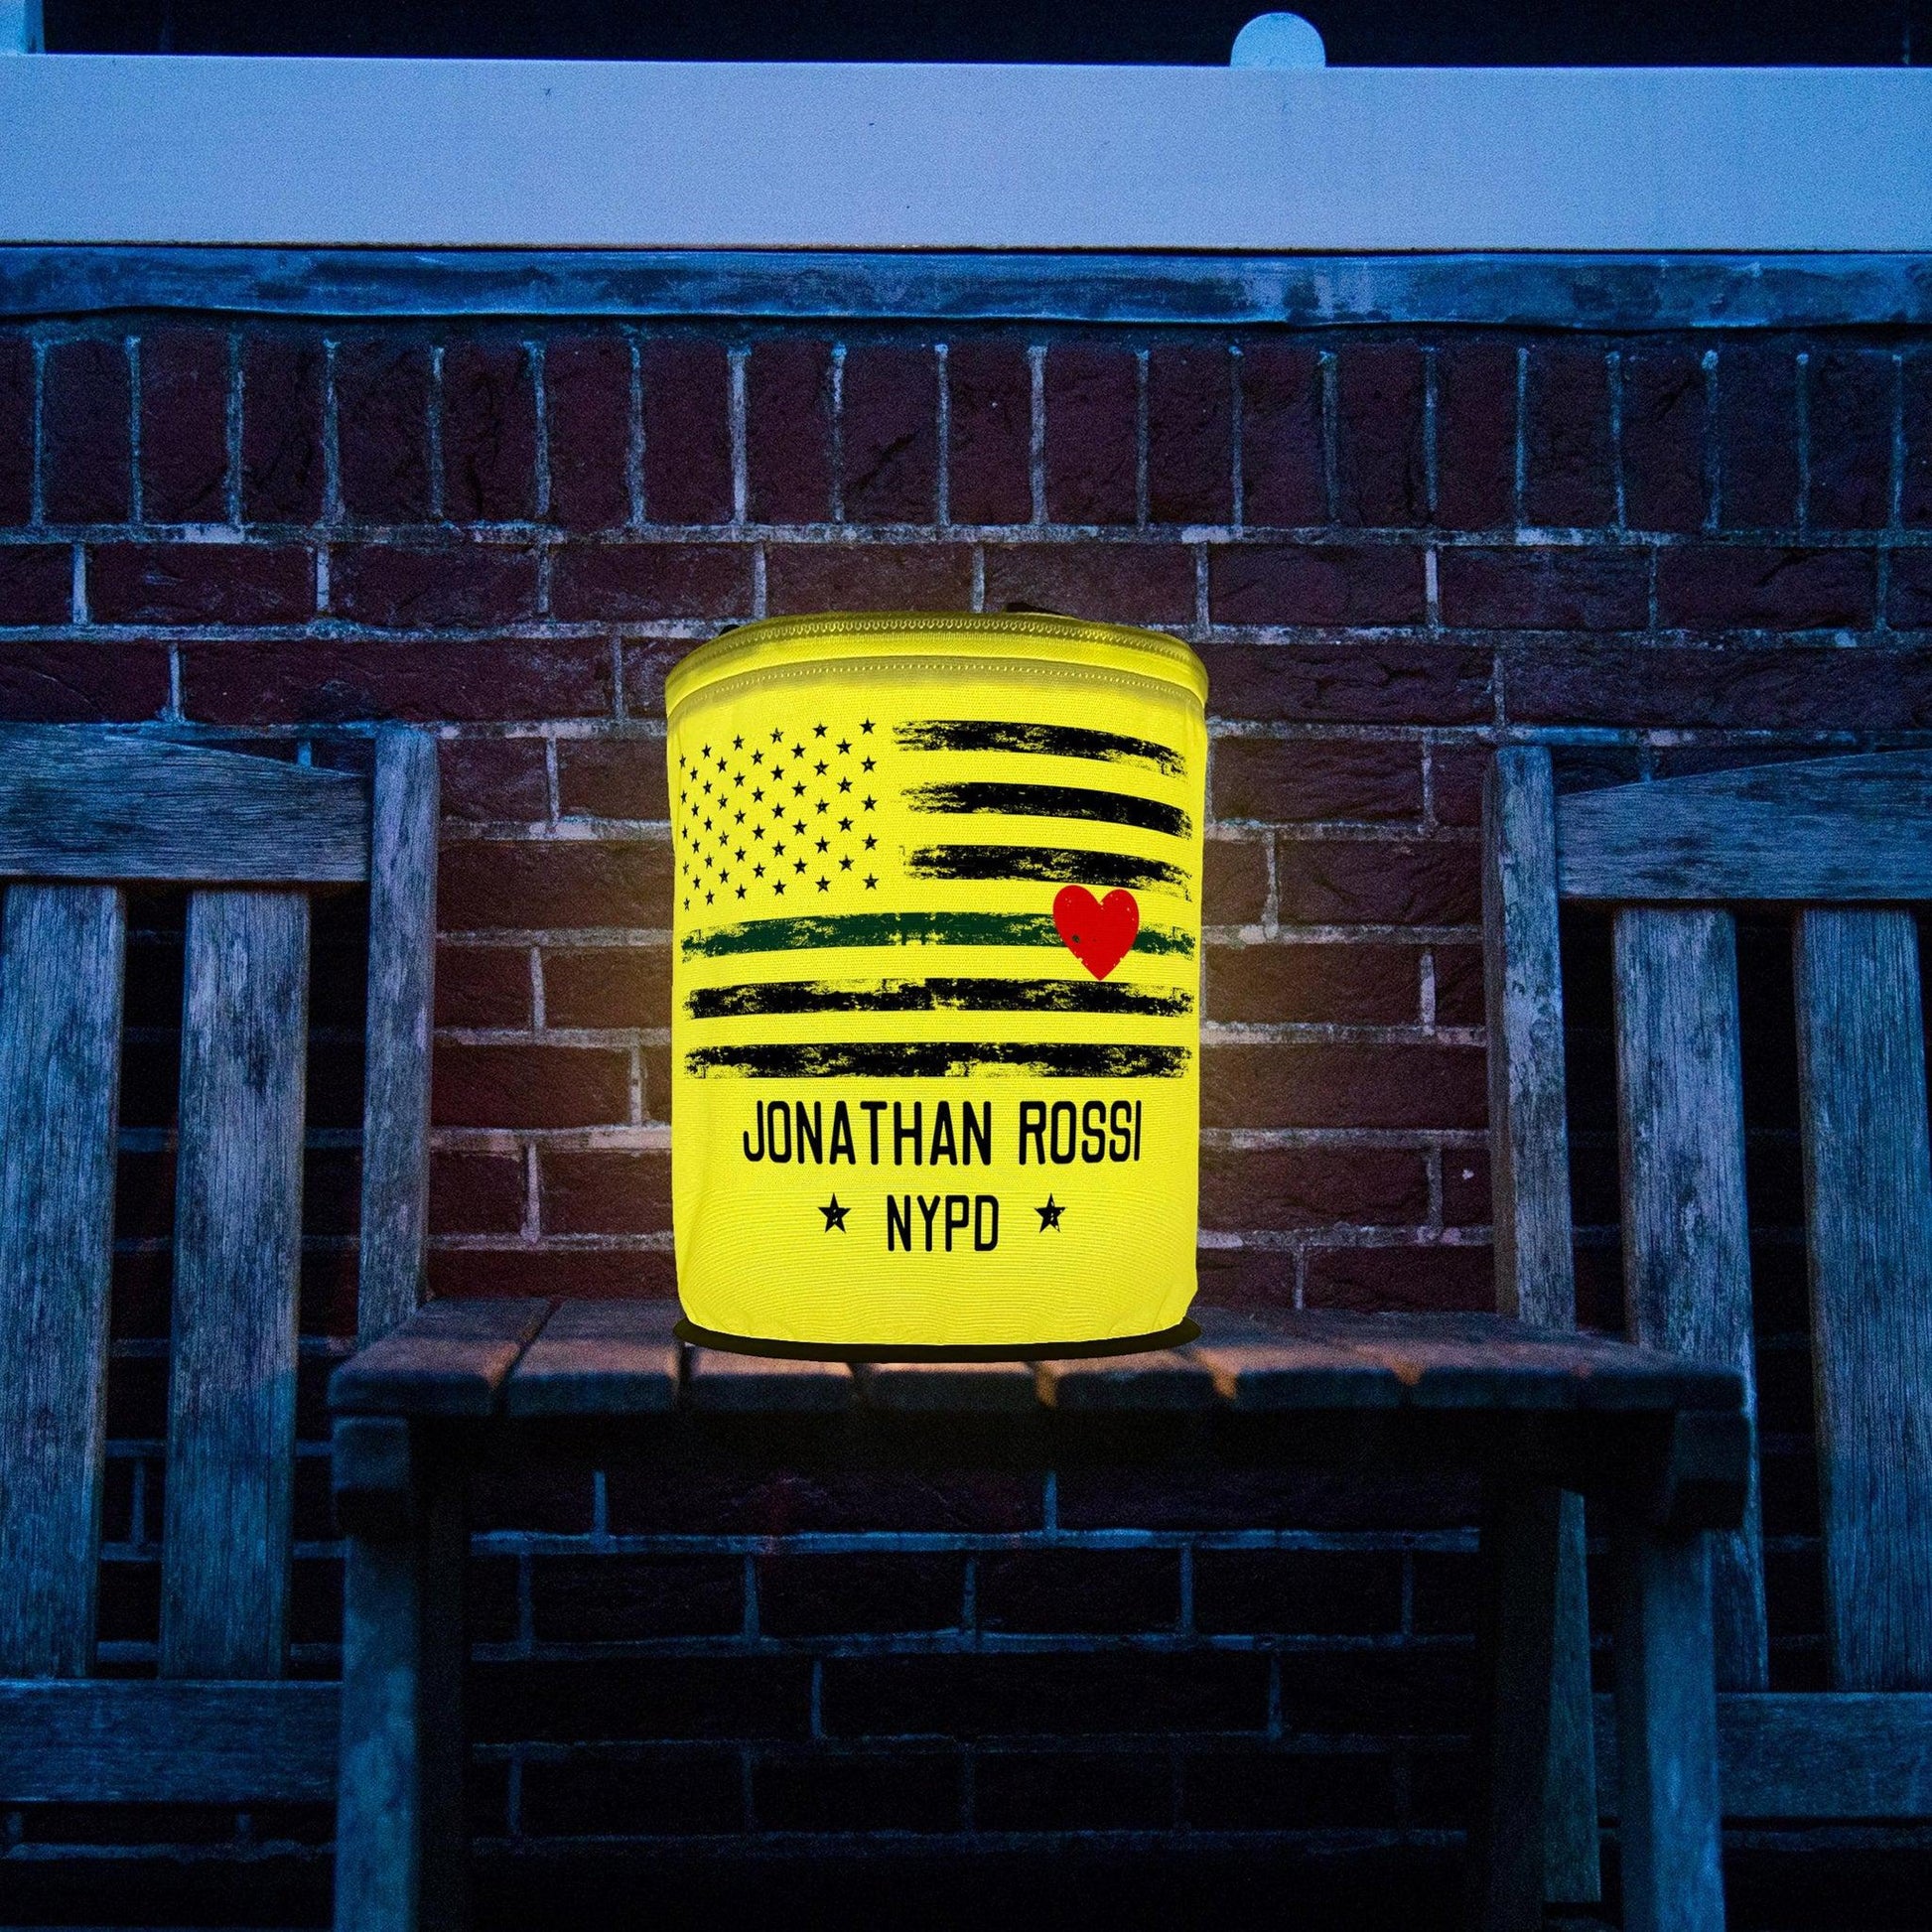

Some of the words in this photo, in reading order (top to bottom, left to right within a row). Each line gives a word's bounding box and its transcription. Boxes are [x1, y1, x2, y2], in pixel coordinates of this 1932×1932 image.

[743, 1100, 992, 1166] JONATHAN
[1019, 1099, 1142, 1166] ROSSI
[887, 1194, 1000, 1252] NYPD
